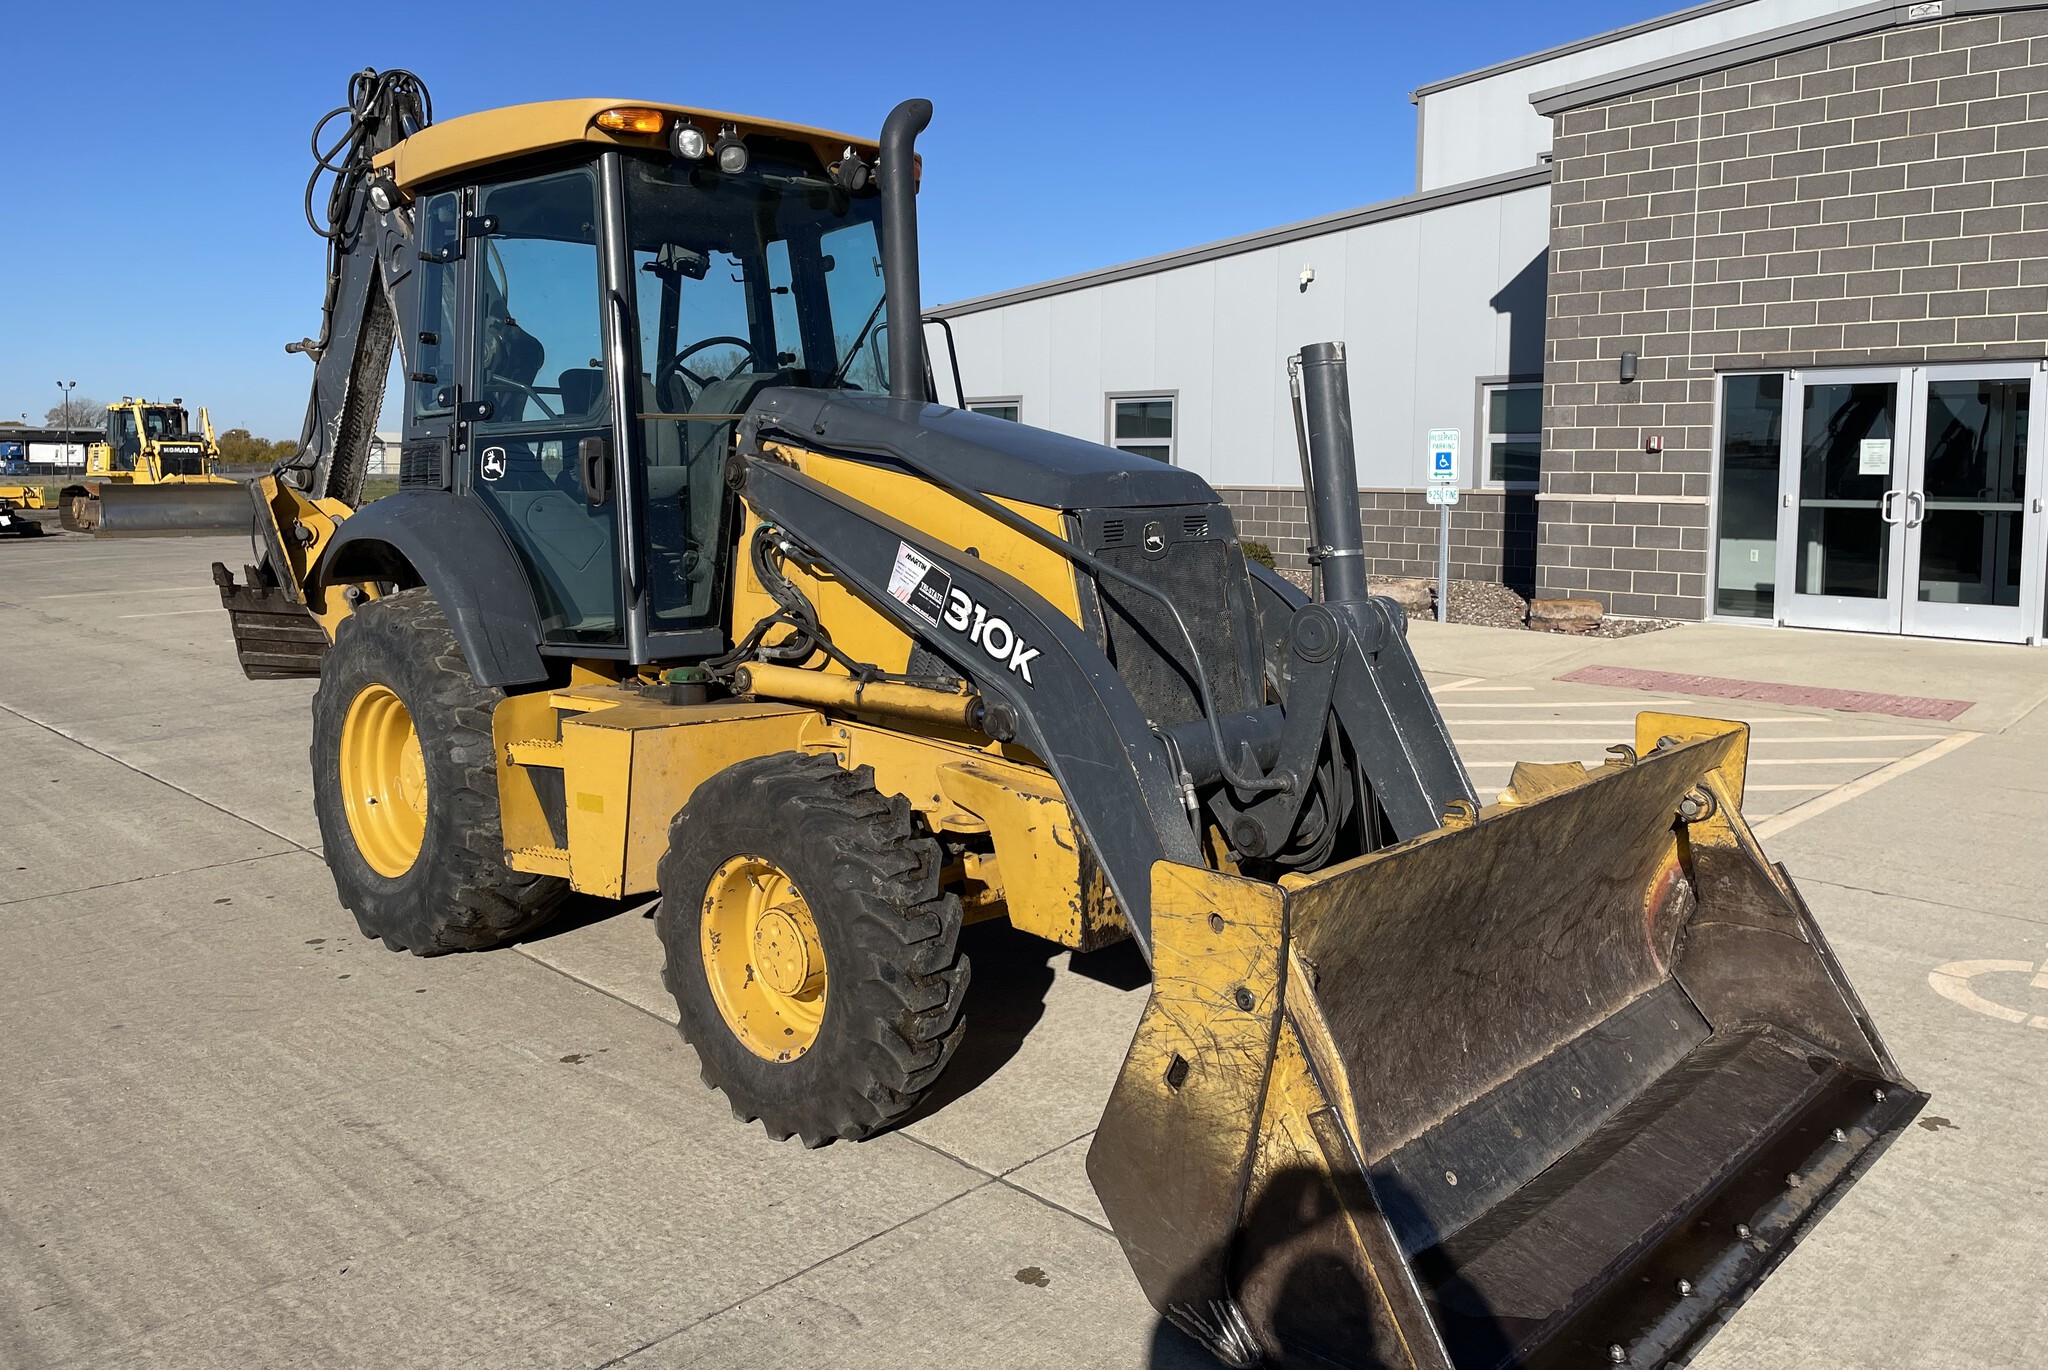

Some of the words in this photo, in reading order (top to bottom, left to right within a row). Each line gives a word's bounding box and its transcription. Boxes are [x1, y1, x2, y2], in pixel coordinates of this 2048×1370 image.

[163, 446, 199, 454] KOMATSU
[1445, 490, 1457, 500] FINE
[905, 553, 927, 571] MARTIN
[944, 588, 1040, 684] 310K
